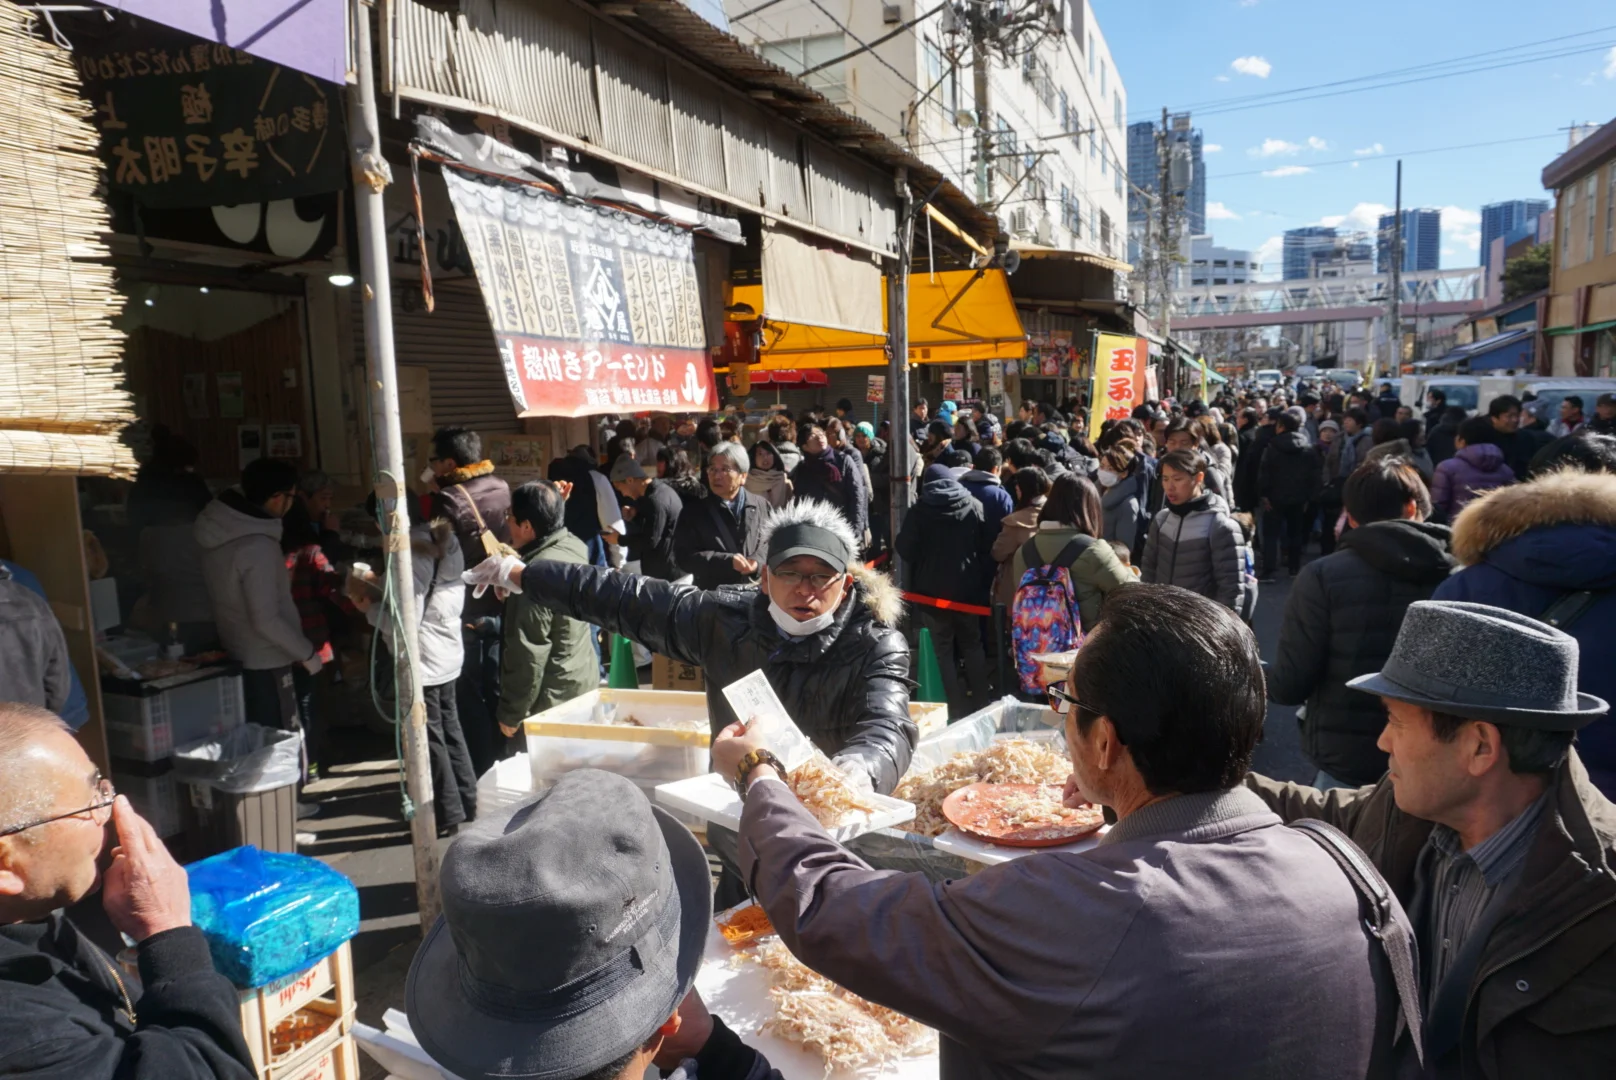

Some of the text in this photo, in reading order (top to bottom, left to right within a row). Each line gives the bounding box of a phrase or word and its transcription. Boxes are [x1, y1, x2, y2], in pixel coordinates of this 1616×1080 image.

[521, 345, 666, 382] 殻付きアーモンド
